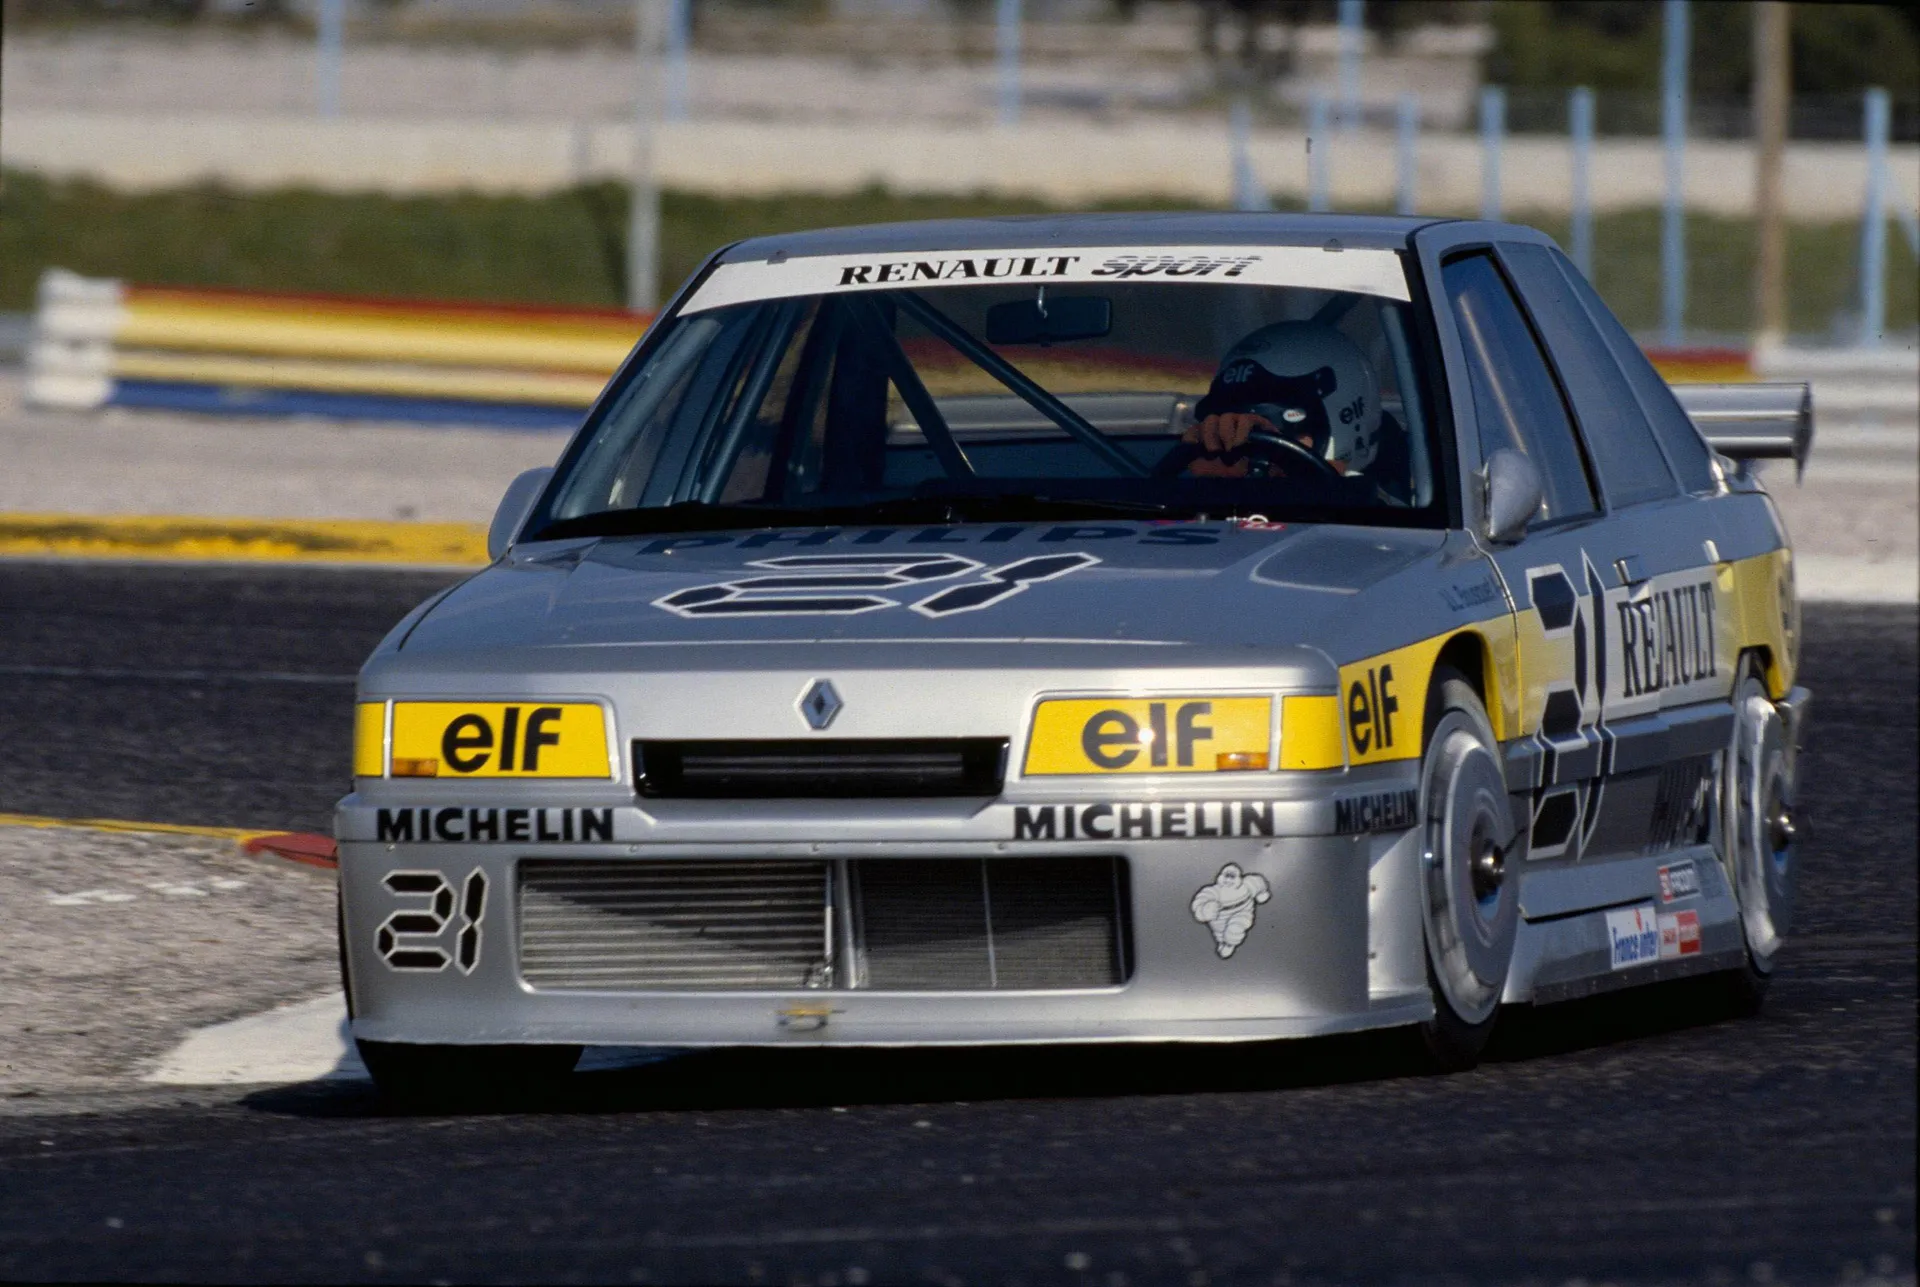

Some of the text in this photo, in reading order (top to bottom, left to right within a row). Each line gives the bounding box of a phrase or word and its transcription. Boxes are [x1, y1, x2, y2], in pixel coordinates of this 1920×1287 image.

[837, 256, 1080, 286] RENAULT
[1223, 364, 1254, 384] elf
[1339, 396, 1365, 424] elf
[636, 525, 1221, 556] PHILIPS
[651, 552, 1102, 618] 21
[1349, 664, 1399, 755] elf
[441, 707, 562, 773] elf
[1080, 702, 1215, 769] elf
[376, 808, 614, 842] MICHELIN
[1013, 802, 1275, 839] MICHELIN
[1335, 790, 1417, 834] MICHELIN
[374, 865, 489, 976] 21
